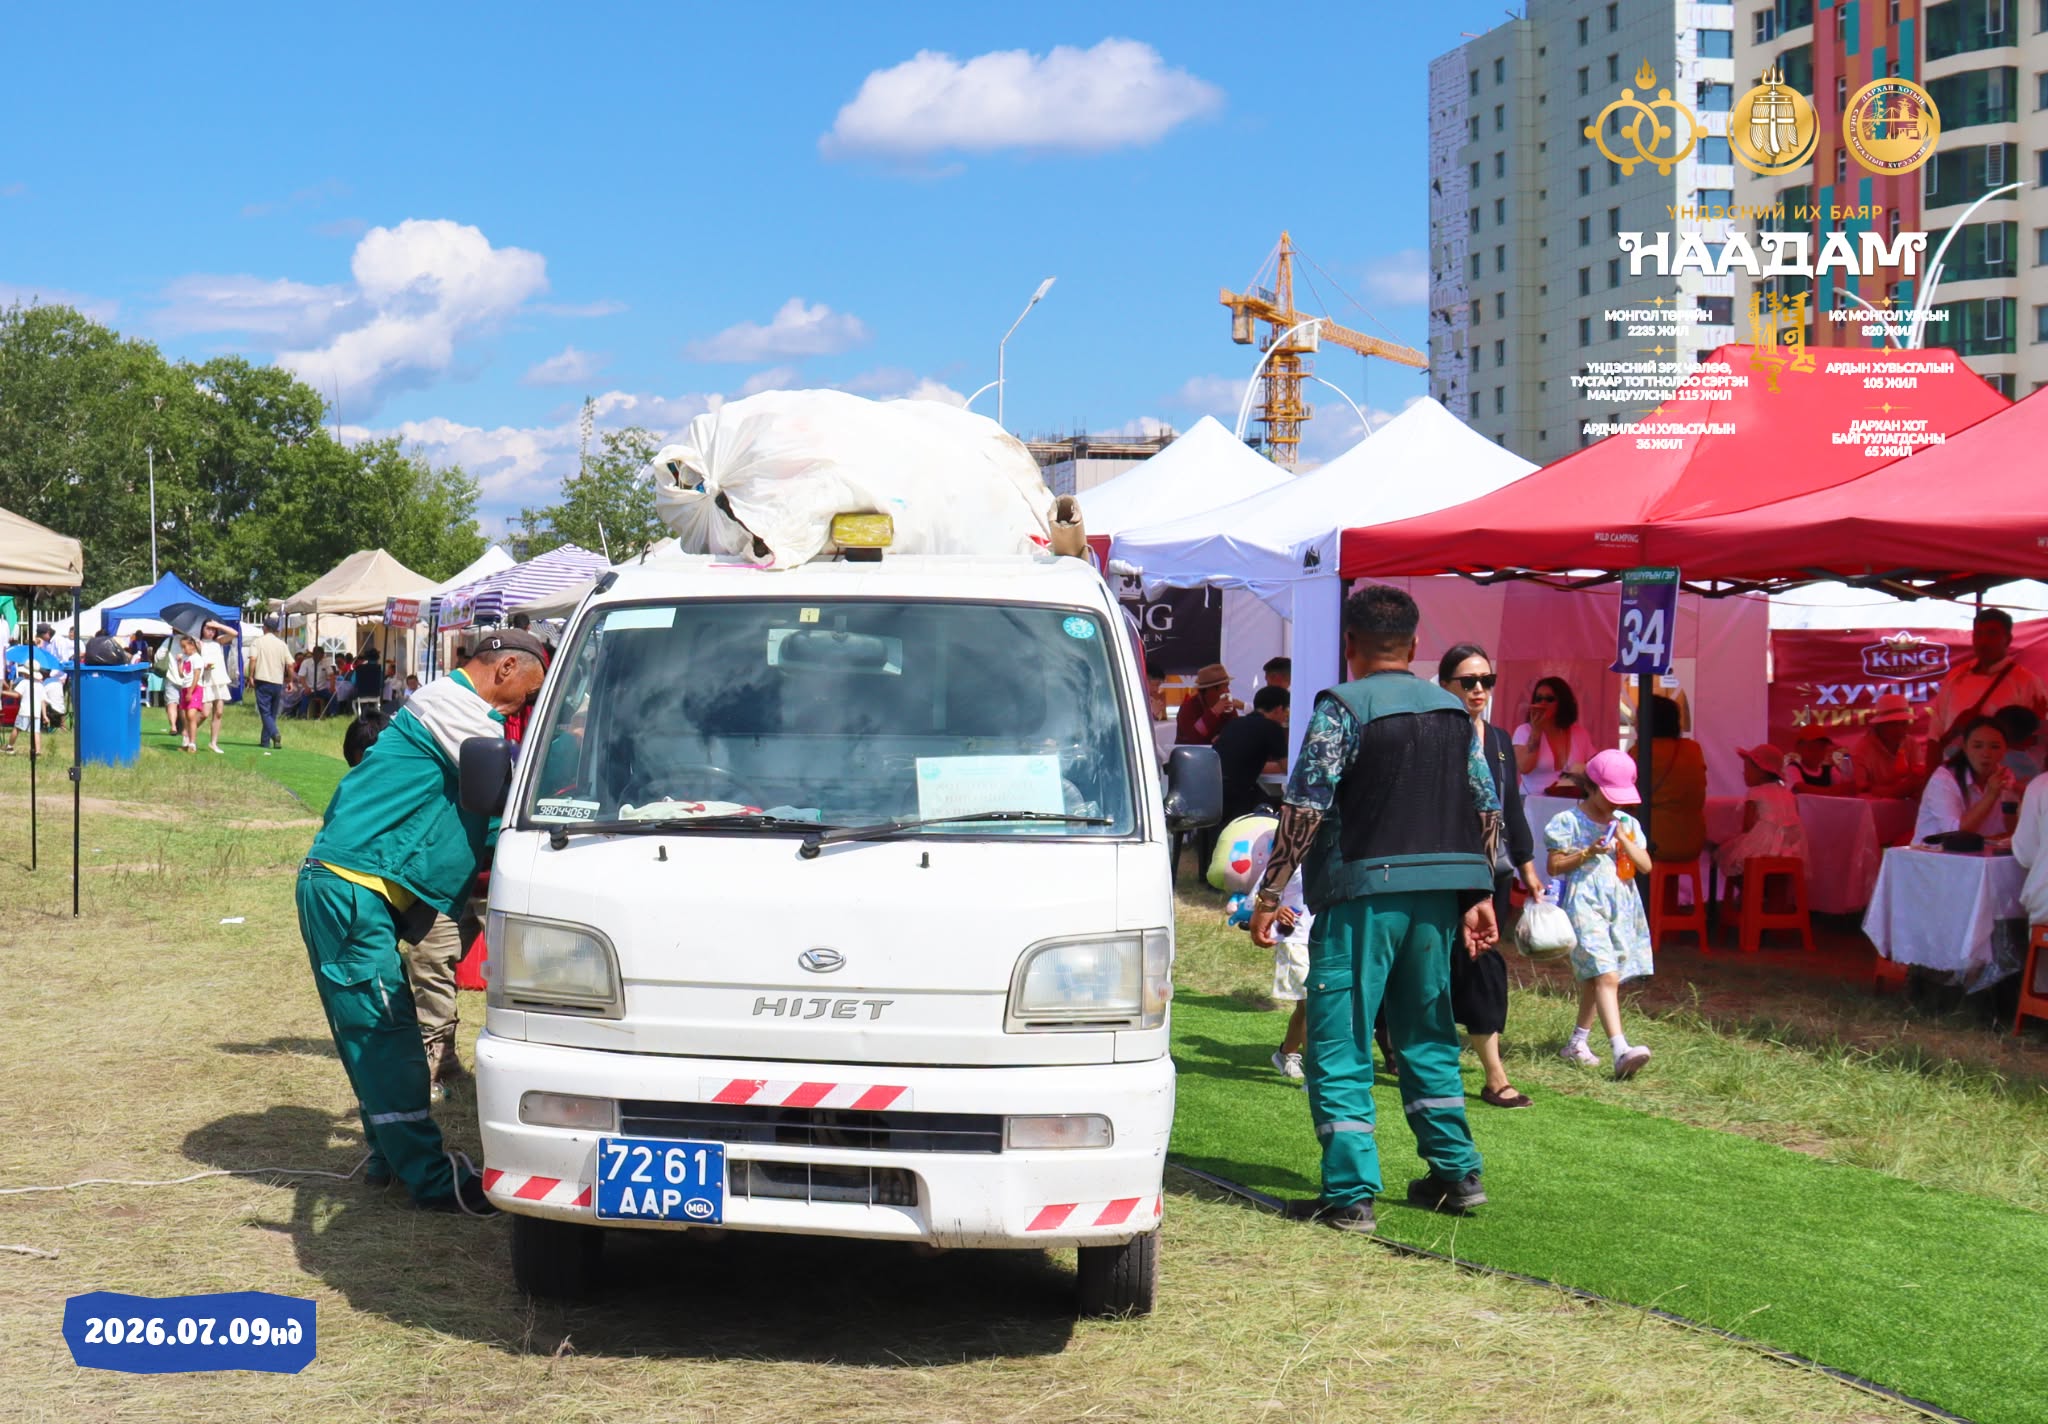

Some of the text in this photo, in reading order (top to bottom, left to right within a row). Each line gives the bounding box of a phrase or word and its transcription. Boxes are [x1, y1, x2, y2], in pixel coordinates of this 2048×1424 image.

[1610, 532, 1640, 544] CAMPING
[1621, 608, 1665, 667] 34
[1872, 649, 1939, 667] KING
[752, 997, 895, 1021] HIJET
[687, 1203, 710, 1215] MGL
